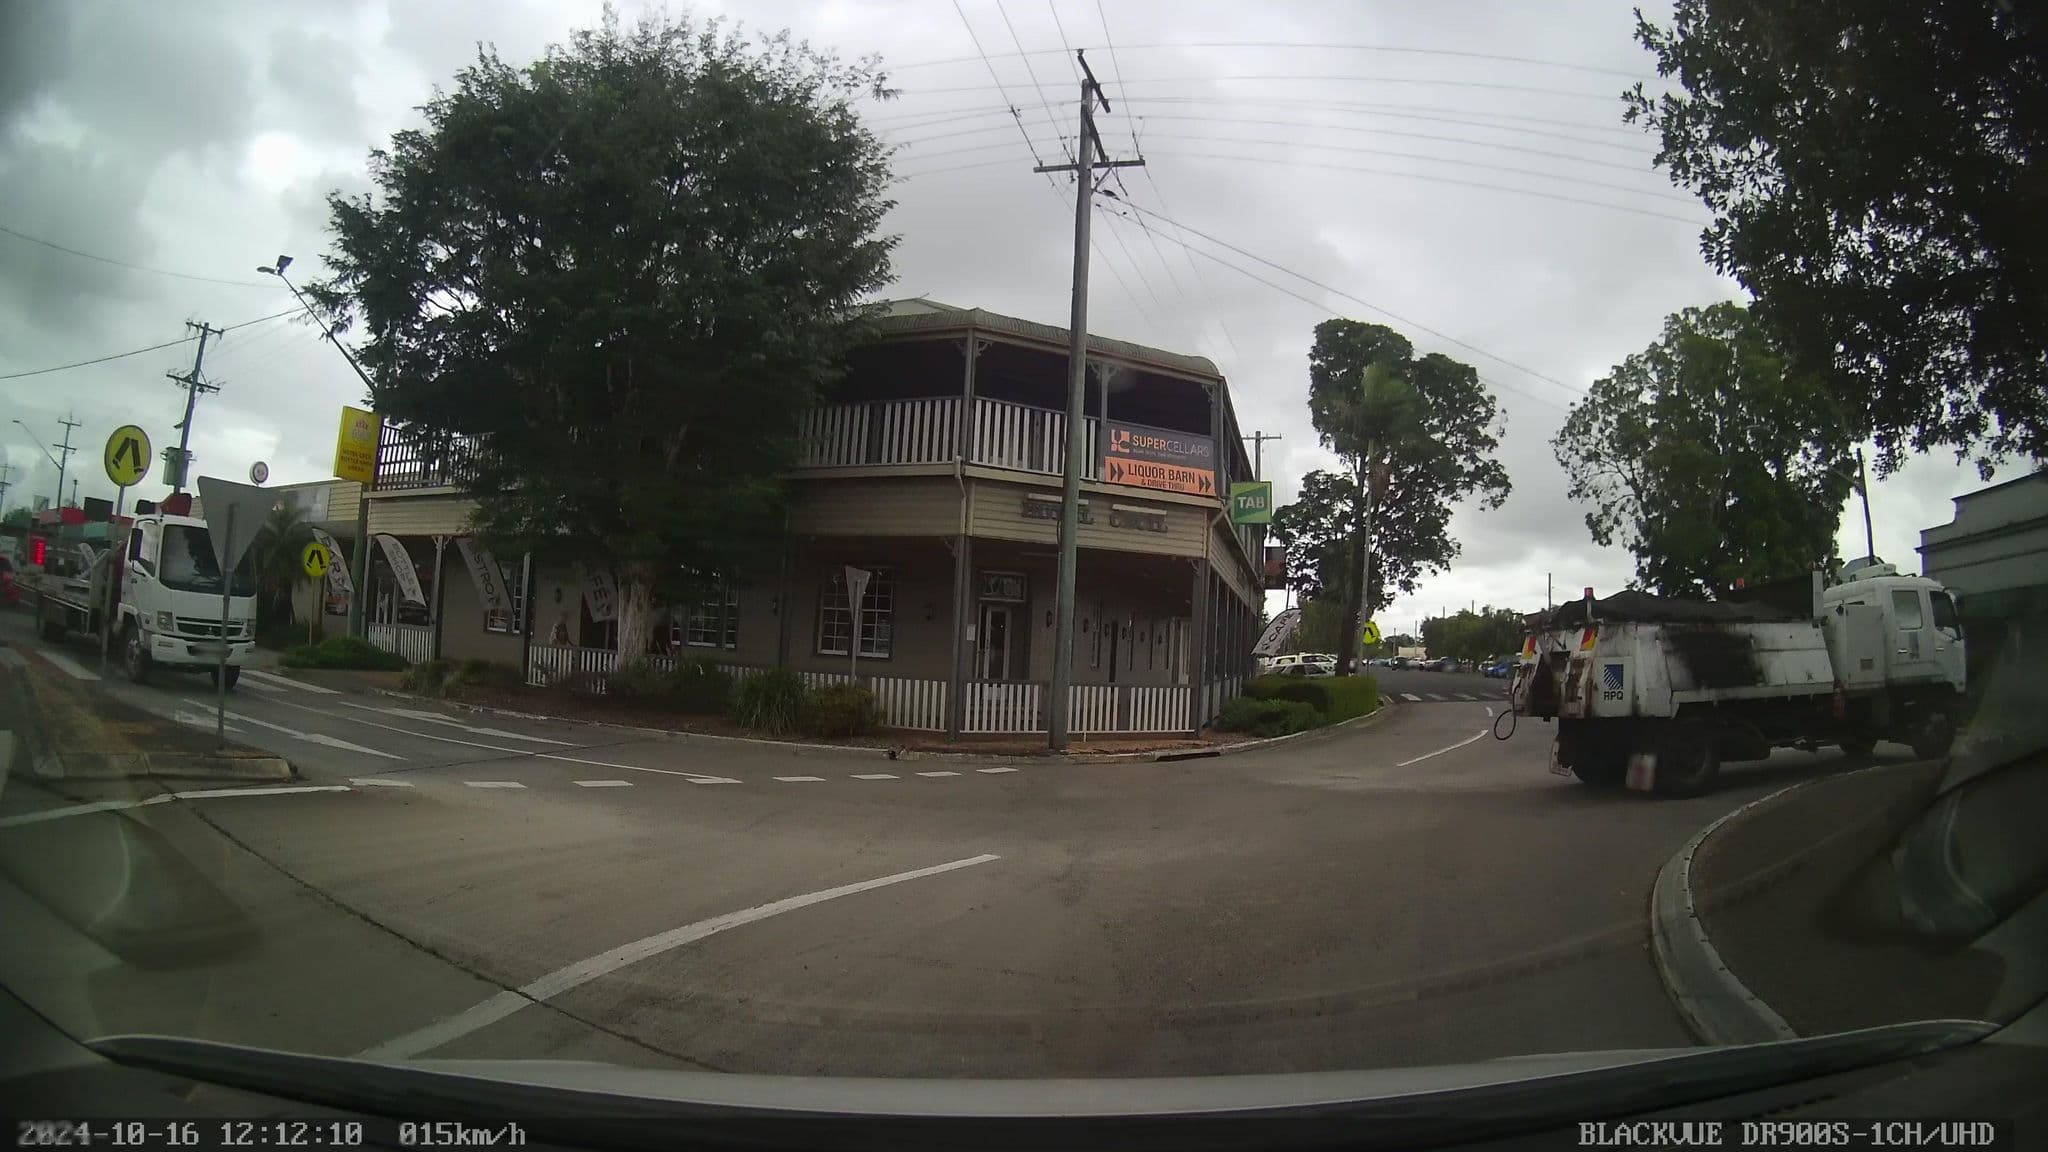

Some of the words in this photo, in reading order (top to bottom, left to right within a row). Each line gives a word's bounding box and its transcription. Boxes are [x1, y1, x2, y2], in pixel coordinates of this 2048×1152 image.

[1132, 435, 1210, 458] SUPERCELLARS
[1128, 463, 1166, 480] LIQUOR
[1168, 469, 1196, 484] BARN
[1147, 479, 1167, 489] DRIVE
[1237, 496, 1265, 509] TAB
[1603, 691, 1624, 701] RPQ
